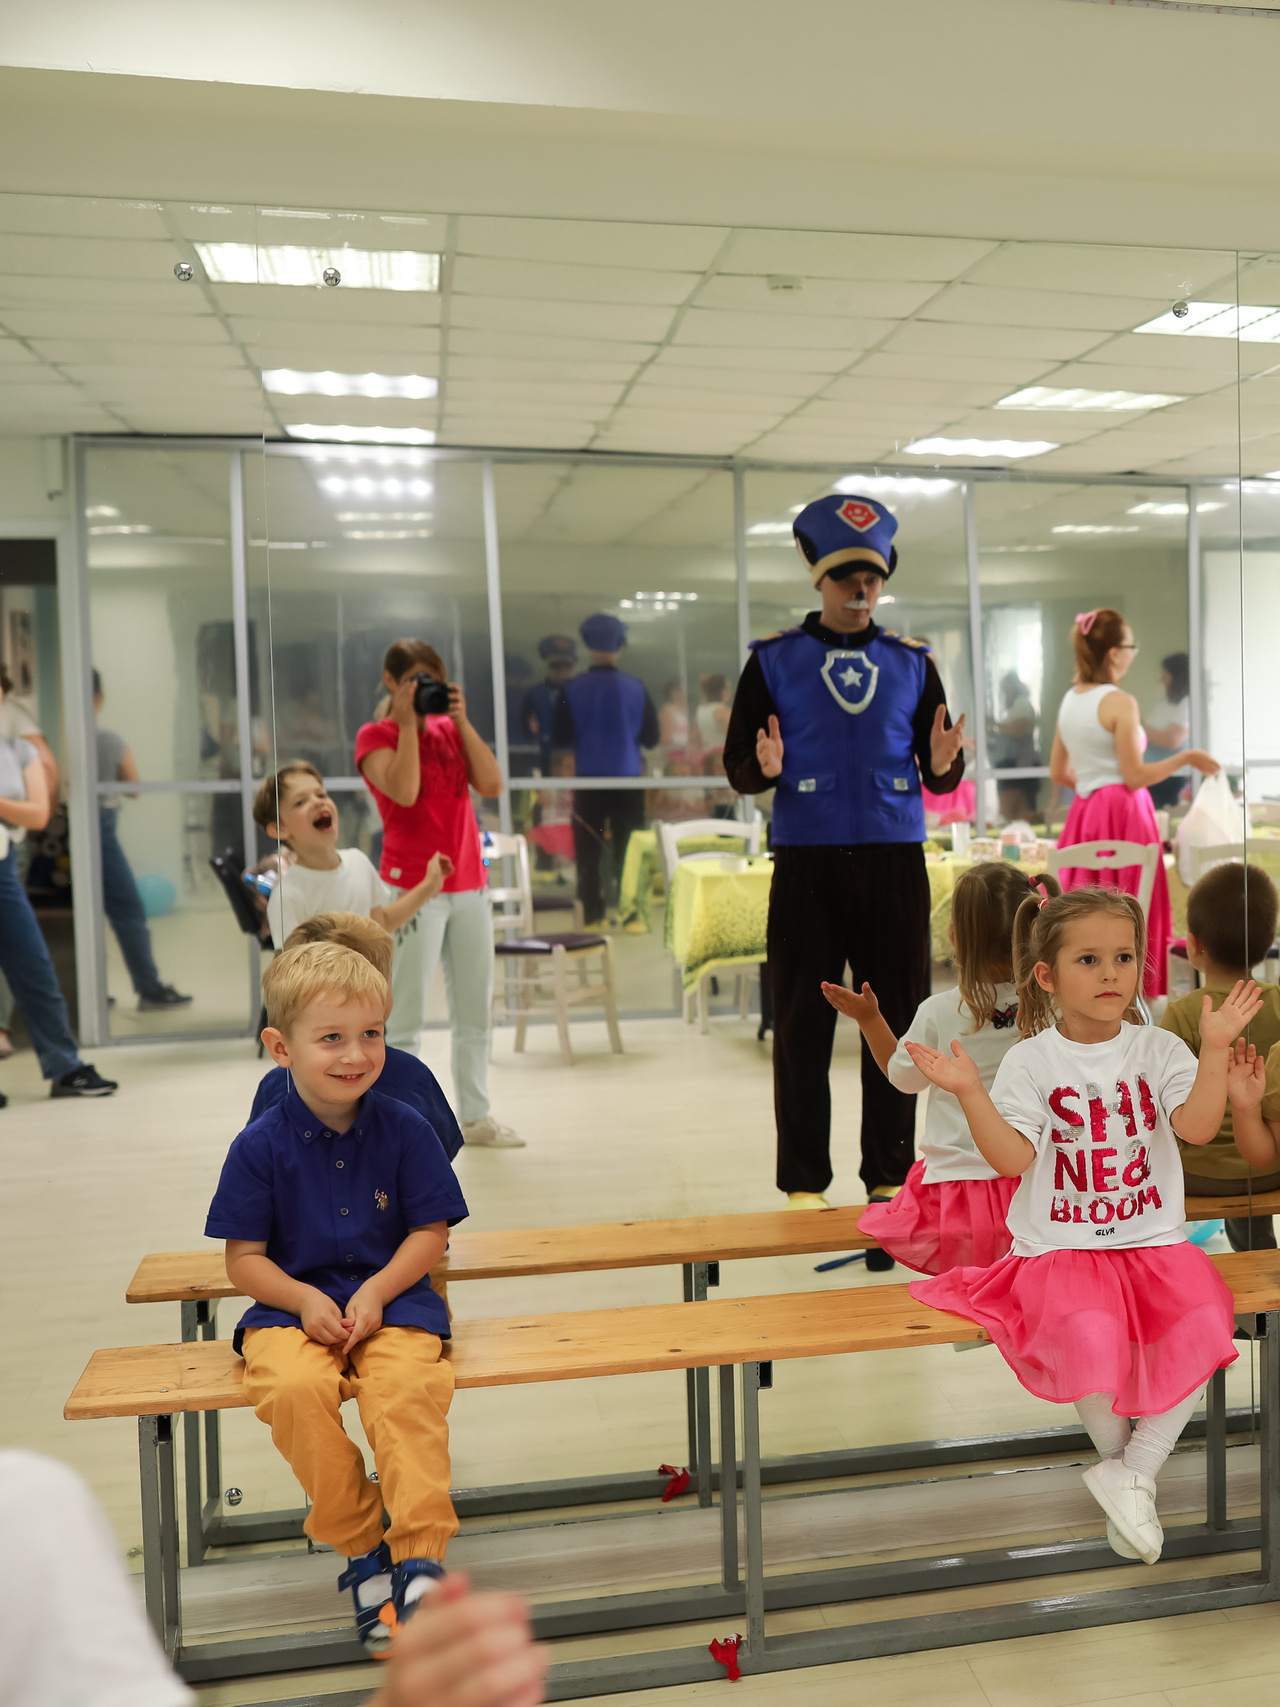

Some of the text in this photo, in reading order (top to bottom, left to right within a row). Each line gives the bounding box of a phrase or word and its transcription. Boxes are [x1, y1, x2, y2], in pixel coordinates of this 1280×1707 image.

[1049, 1072, 1156, 1143] SHI
[1050, 1185, 1162, 1224] BLOOM
[1095, 1227, 1115, 1237] GLVR
